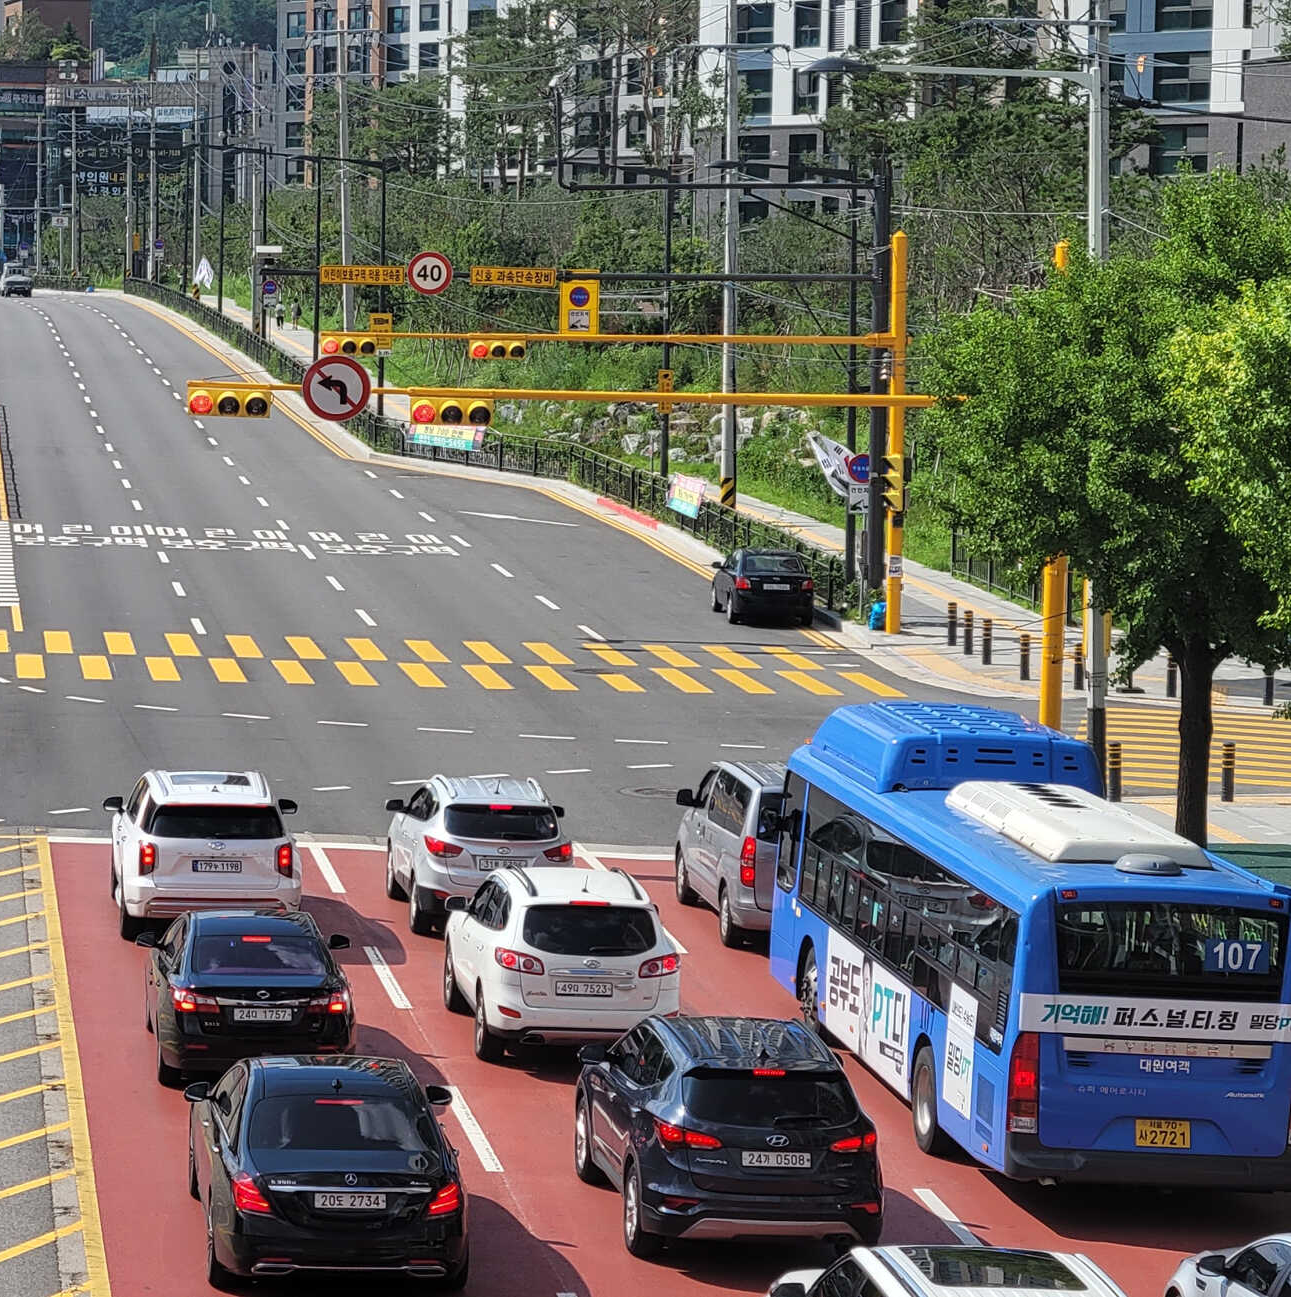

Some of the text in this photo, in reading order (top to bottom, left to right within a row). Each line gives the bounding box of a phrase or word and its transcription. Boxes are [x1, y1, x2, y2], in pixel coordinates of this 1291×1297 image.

[417, 265, 442, 282] 40
[475, 270, 553, 285] 신호 과속단속장비
[14, 535, 148, 548] 보호구역
[160, 538, 297, 552] 보호구역
[319, 543, 460, 557] 보호구역
[221, 863, 239, 871] 1198
[1213, 942, 1262, 970] 107
[584, 984, 607, 994] 7523
[829, 956, 861, 1015] 공부도
[264, 1010, 287, 1020] 1757
[1040, 1003, 1108, 1026] 기억해!
[1113, 1007, 1239, 1031] 퍼.스.널.티.칭
[1139, 1059, 1190, 1074] 대원여객
[1164, 1121, 1177, 1129] 70
[748, 1153, 805, 1166] 24가 0508
[321, 1195, 381, 1207] 20도 2734
